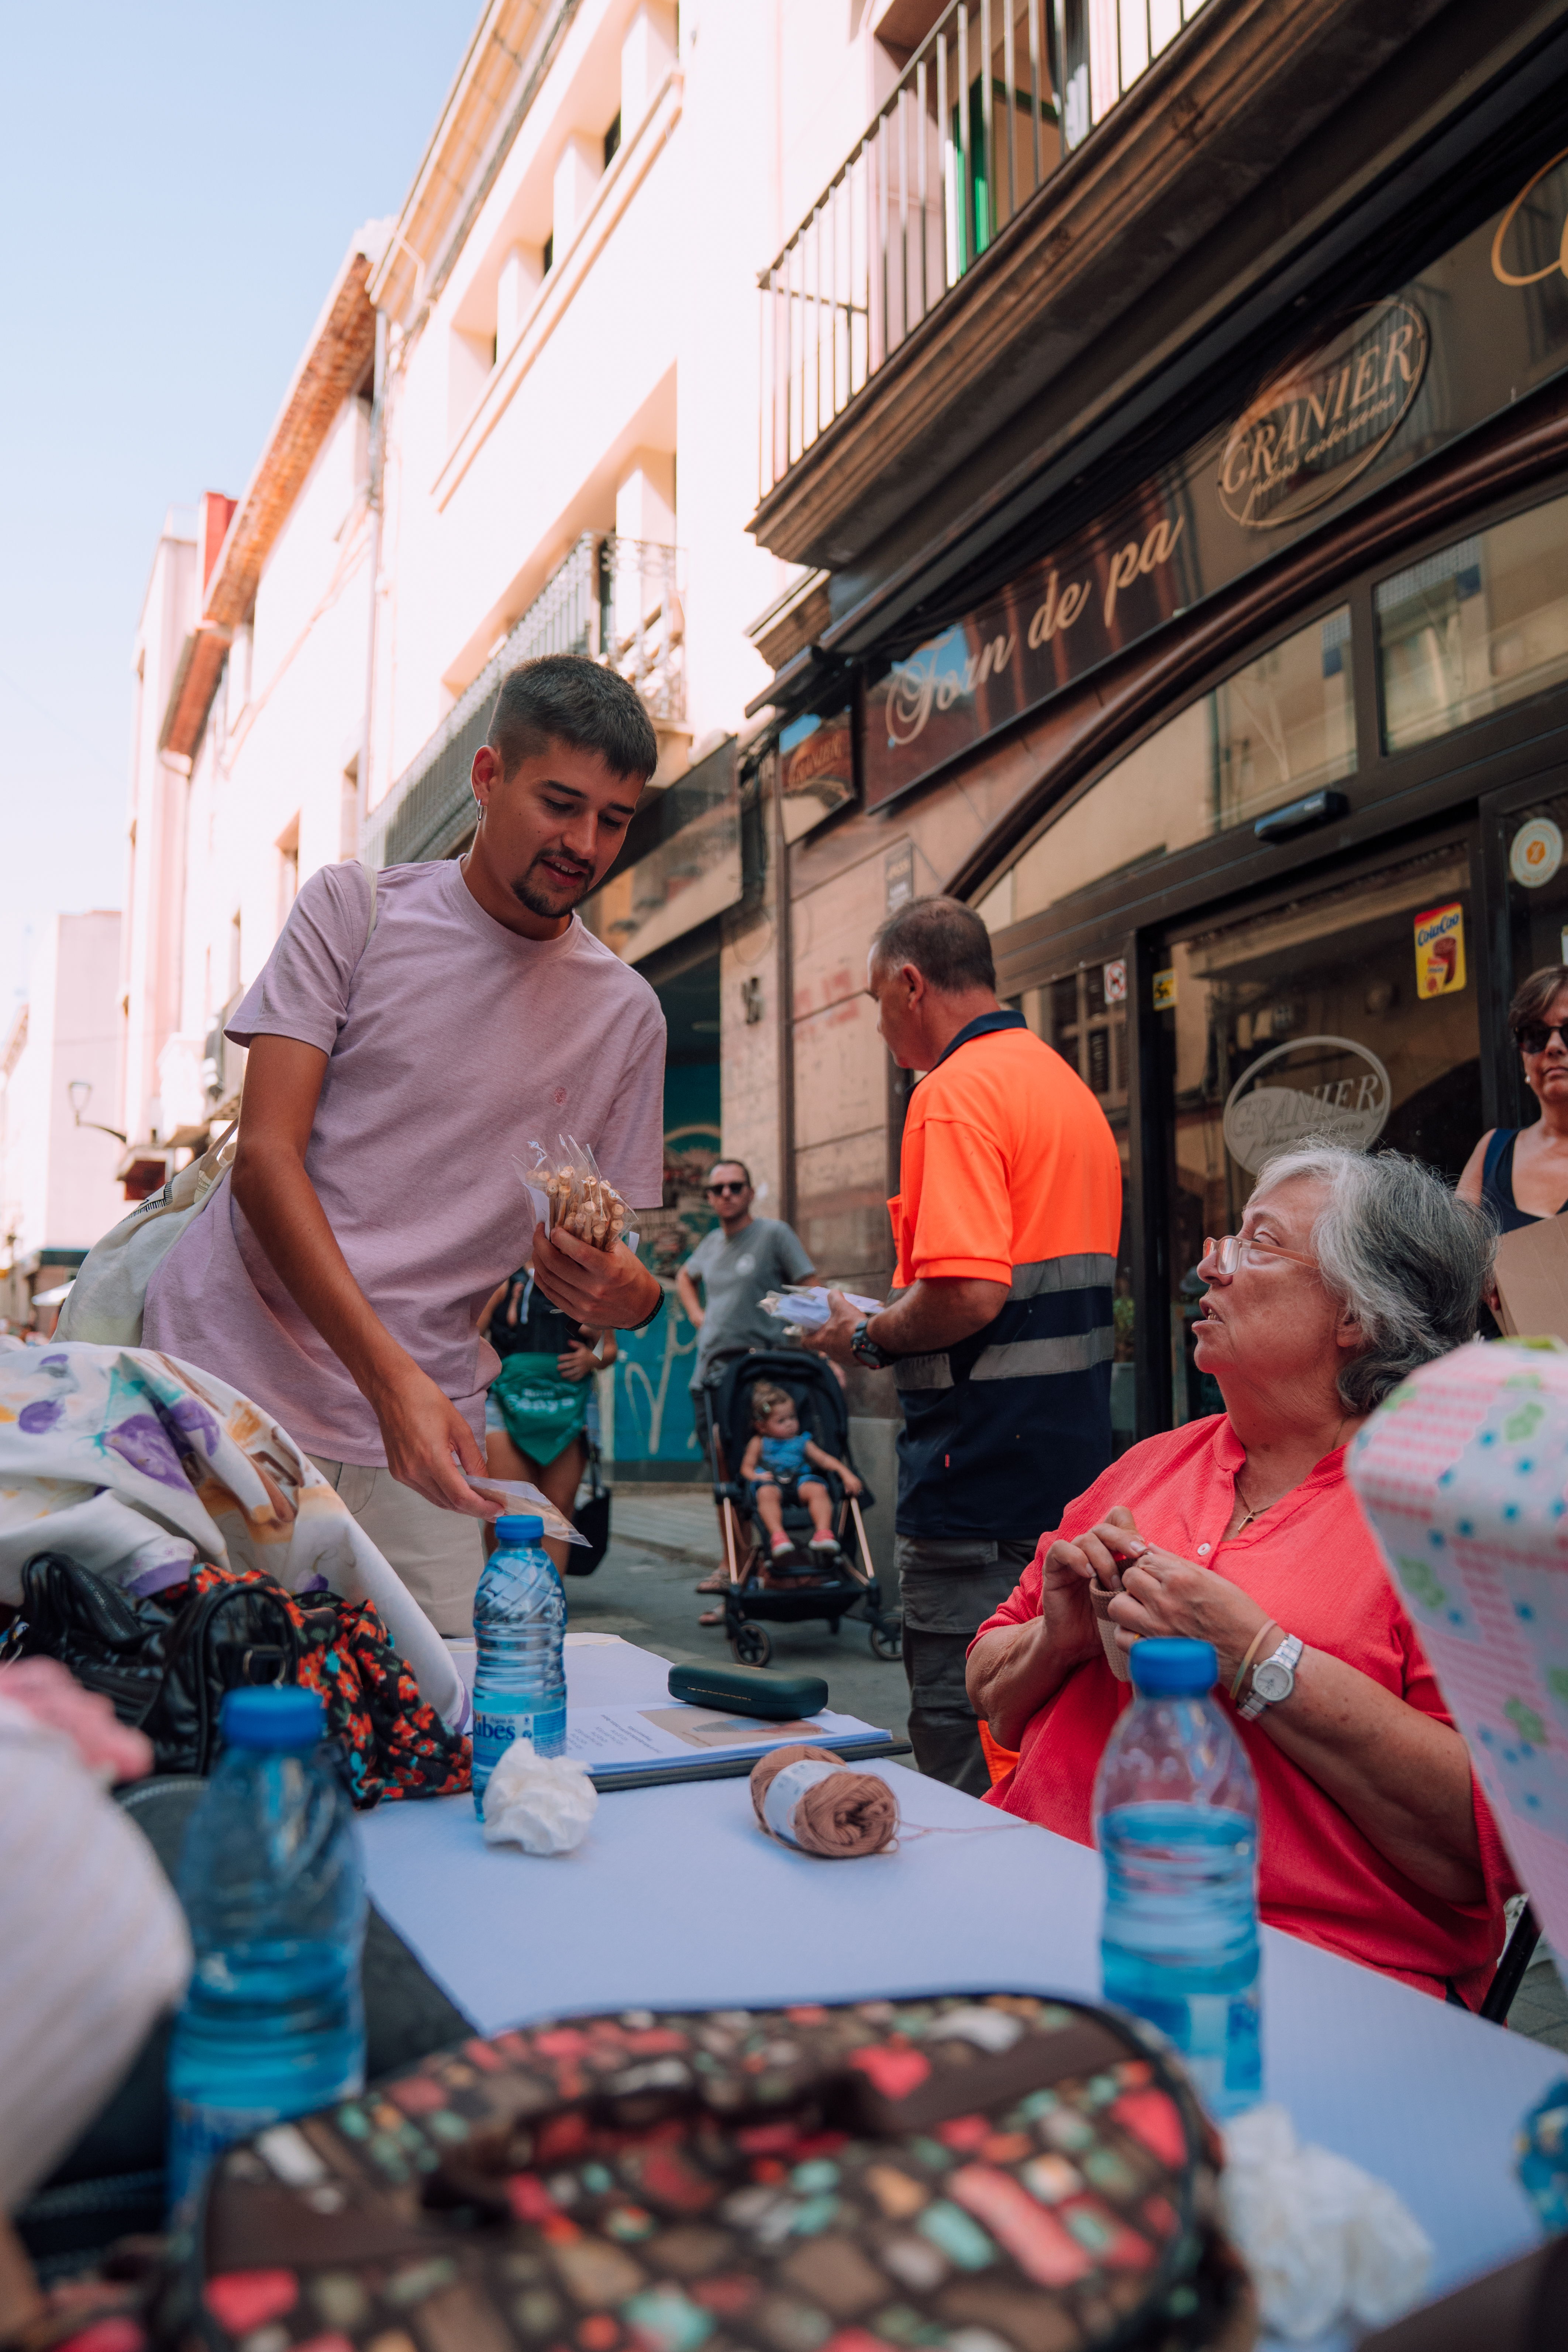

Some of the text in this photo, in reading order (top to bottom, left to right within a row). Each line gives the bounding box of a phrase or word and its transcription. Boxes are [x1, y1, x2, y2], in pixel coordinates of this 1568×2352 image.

[1223, 324, 1418, 494] GRANIER
[1028, 570, 1091, 650] de
[1105, 514, 1185, 628] pa
[1233, 1074, 1383, 1137] GRANIER
[654, 1299, 662, 1314] per
